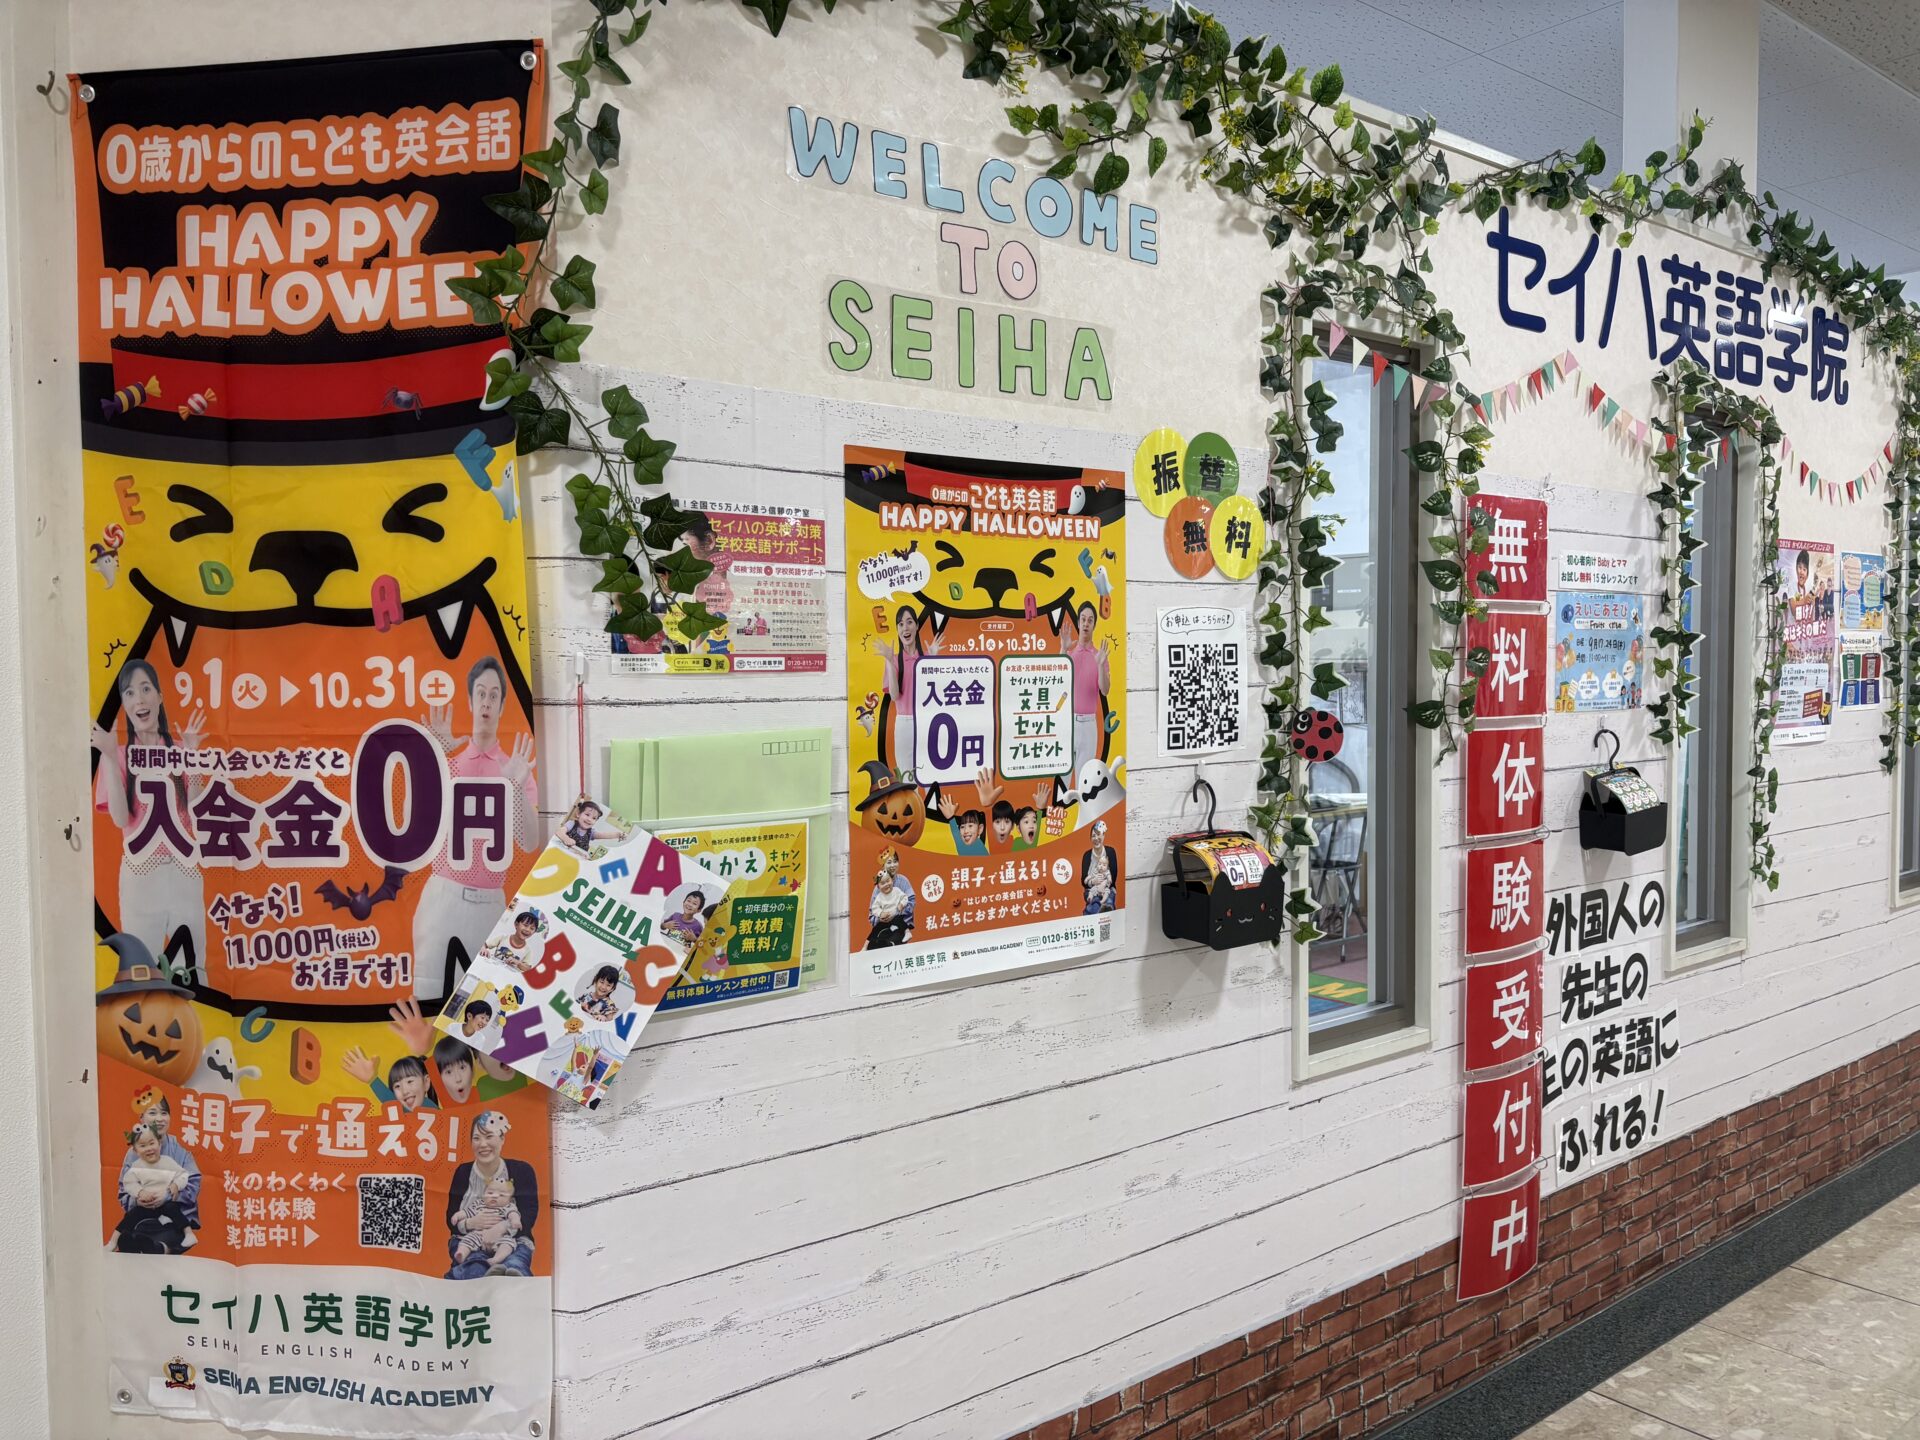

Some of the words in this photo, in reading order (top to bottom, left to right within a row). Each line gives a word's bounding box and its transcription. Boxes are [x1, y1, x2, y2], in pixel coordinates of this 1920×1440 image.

[106, 108, 511, 185] 0歳からのこども英会話
[788, 106, 1158, 265] WELCOME
[185, 202, 429, 268] HAPPY
[940, 222, 1038, 300] TO
[100, 262, 518, 330] HALLOWEE
[1486, 205, 1850, 406] セイハ英語学院
[828, 279, 1113, 401] SEIHA
[931, 484, 1056, 513] 0歳からのこども英会話
[881, 505, 965, 532] HAPPY
[973, 511, 1100, 539] HALLOWEEN
[715, 536, 824, 557] 学校英語サポート
[803, 556, 824, 564] コース
[921, 665, 990, 676] 期間中にご入会いただくと
[922, 679, 986, 707] 入会金
[1018, 687, 1050, 712] 文具
[1014, 714, 1056, 735] セット
[926, 712, 985, 770] 0円
[1009, 741, 1064, 760] プレゼント
[130, 748, 346, 772] 期間中にご入会いただくと
[665, 836, 698, 846] SEIHA
[562, 878, 653, 947] SEIHA
[744, 903, 785, 914] 初年度分の
[1545, 880, 1665, 956] 外国人の
[738, 917, 784, 935] 教材費
[1042, 928, 1095, 945] 0120-815-718
[999, 941, 1024, 951] ACADEMY
[871, 951, 948, 975] セイハ英語学院
[1561, 952, 1649, 1025] 先生の
[224, 1169, 347, 1192] 秋のわくわく
[226, 1197, 316, 1222] 無料体験
[161, 1284, 492, 1350] セイハ英語学院
[187, 1335, 238, 1355] SEIHA
[261, 1344, 353, 1360] ENGLISH
[374, 1354, 471, 1372] ACADEMY
[204, 1367, 261, 1395] SEIHA
[269, 1375, 365, 1403] ENGLISH
[370, 1385, 494, 1408] ACADEMY
